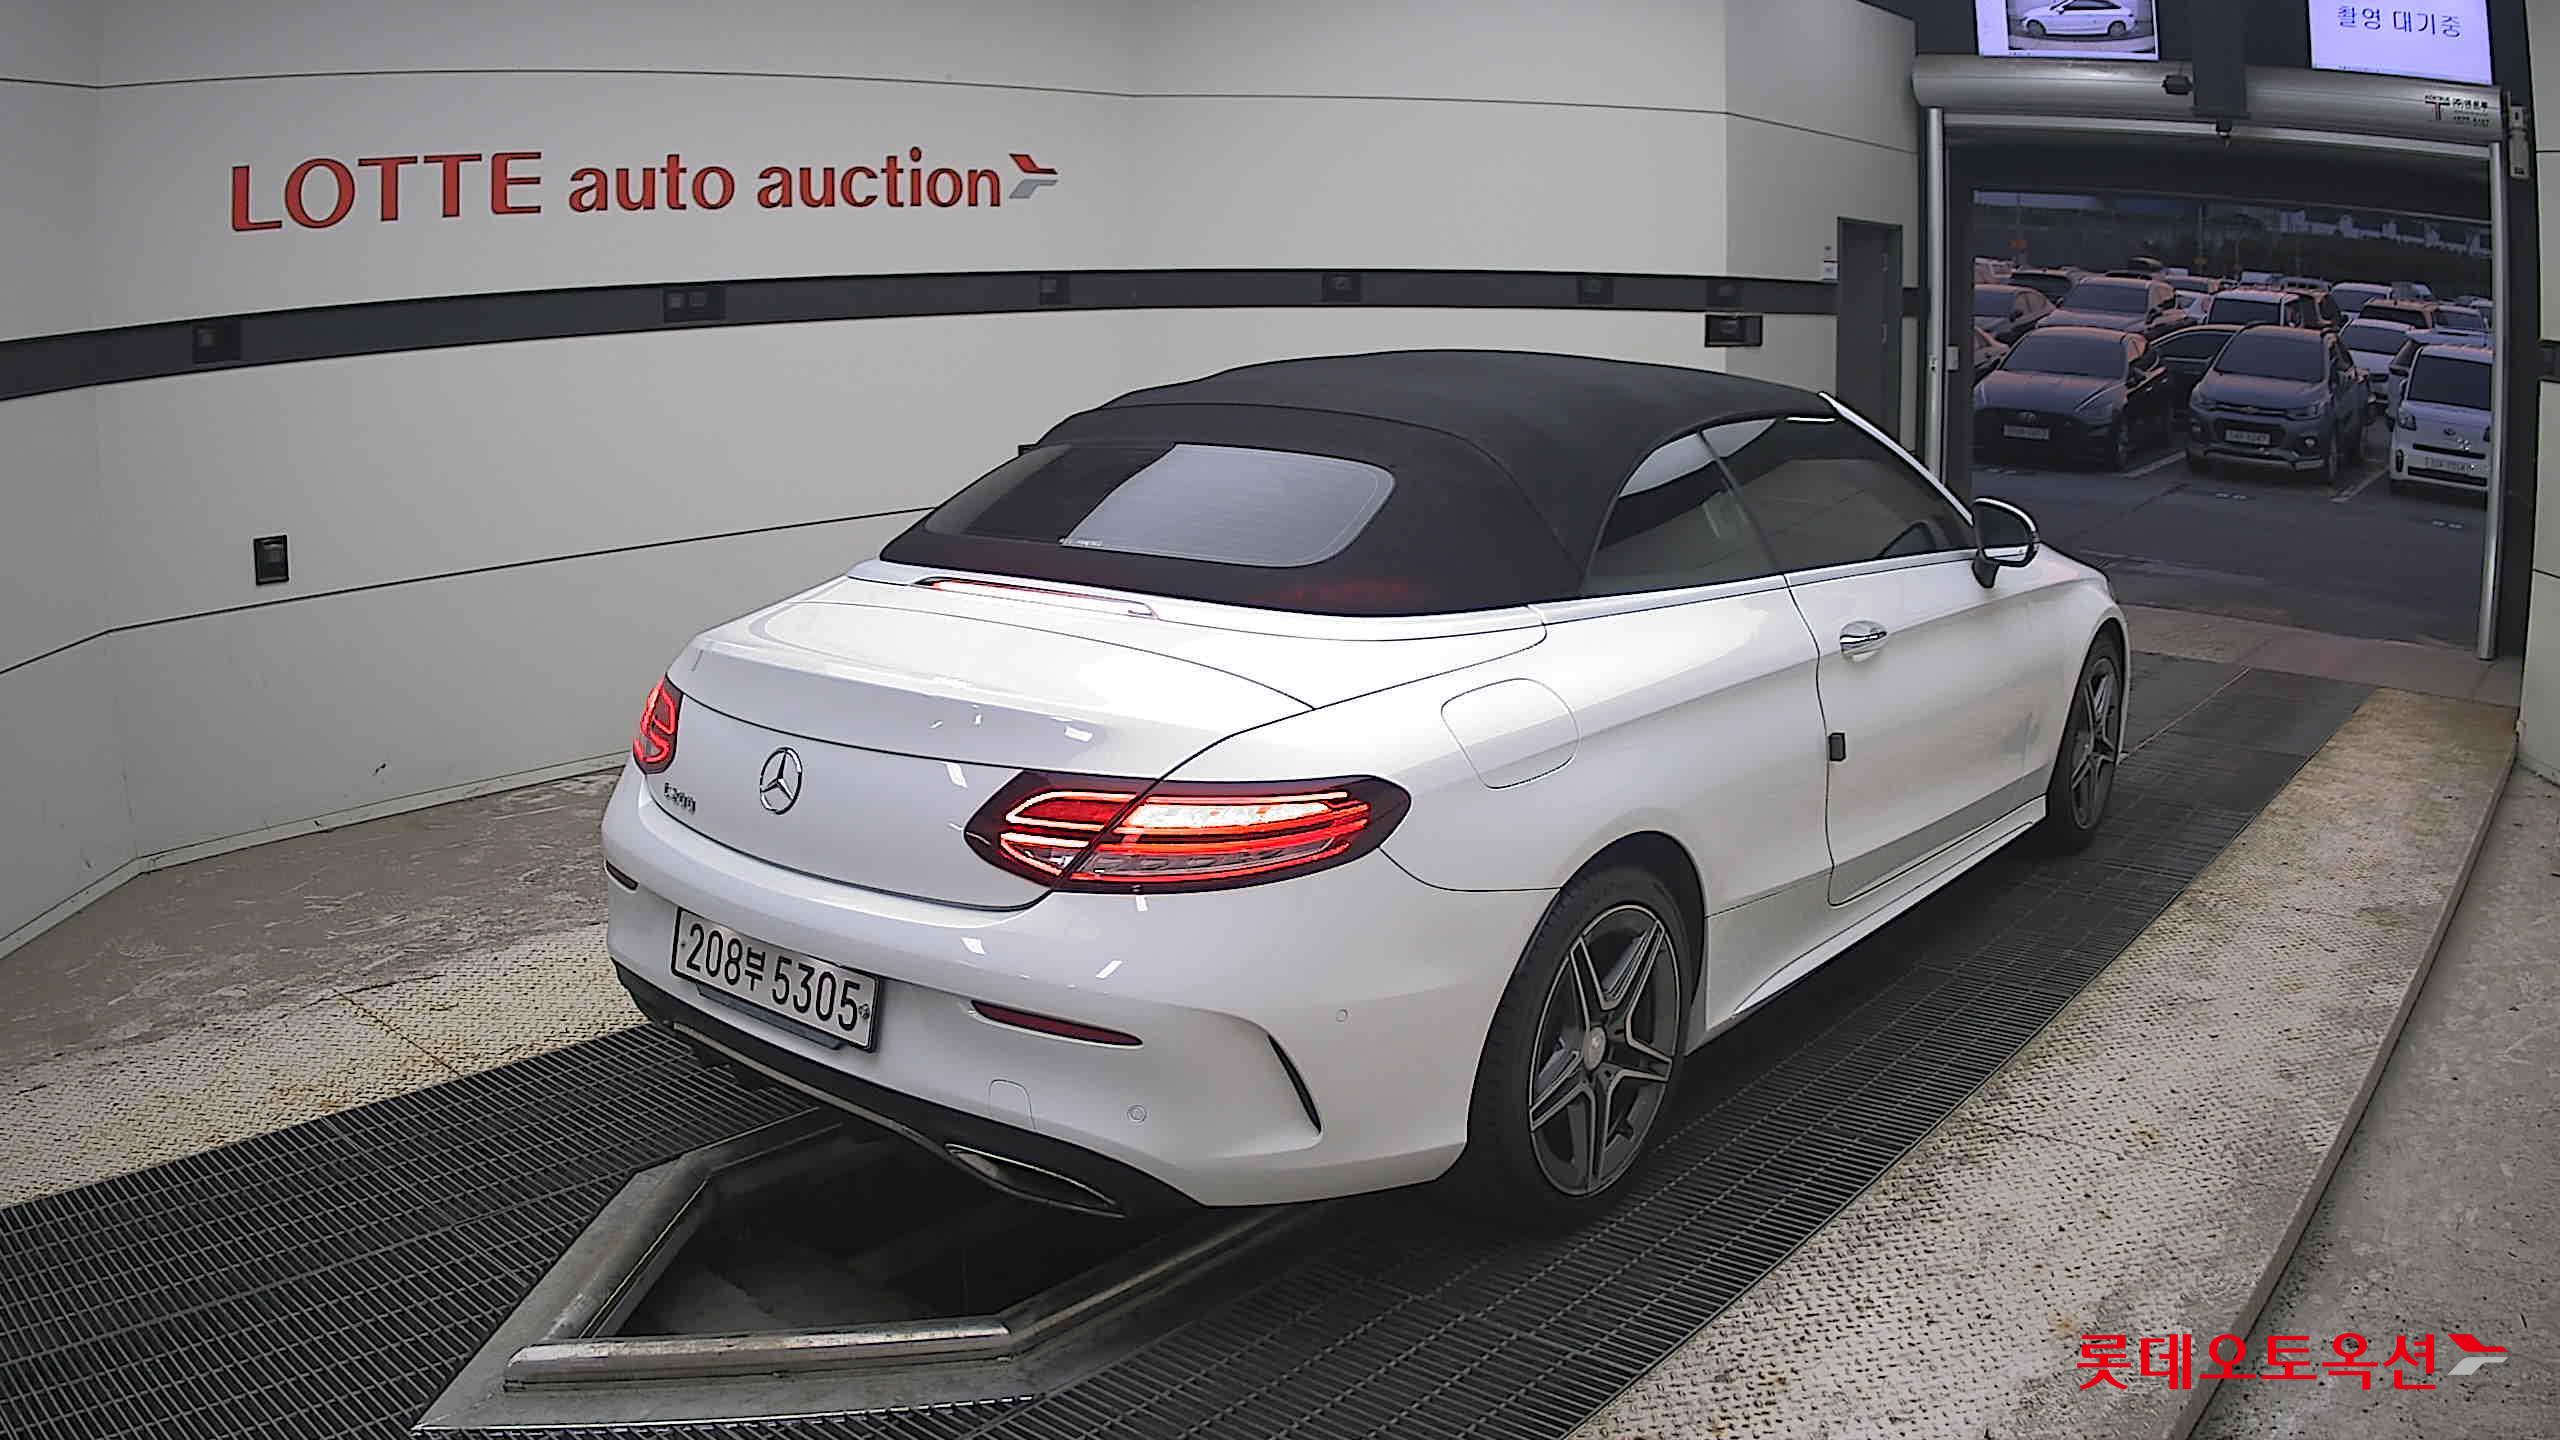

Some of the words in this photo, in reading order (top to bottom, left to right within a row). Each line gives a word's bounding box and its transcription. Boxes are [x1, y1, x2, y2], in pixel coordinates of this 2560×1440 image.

[2338, 5, 2382, 31] 촬영
[2392, 10, 2462, 39] 대기중
[230, 151, 543, 232] LOTTE
[568, 153, 736, 213] auto
[756, 146, 1001, 208] auction
[686, 923, 766, 992] 208부
[772, 955, 860, 1032] 5305
